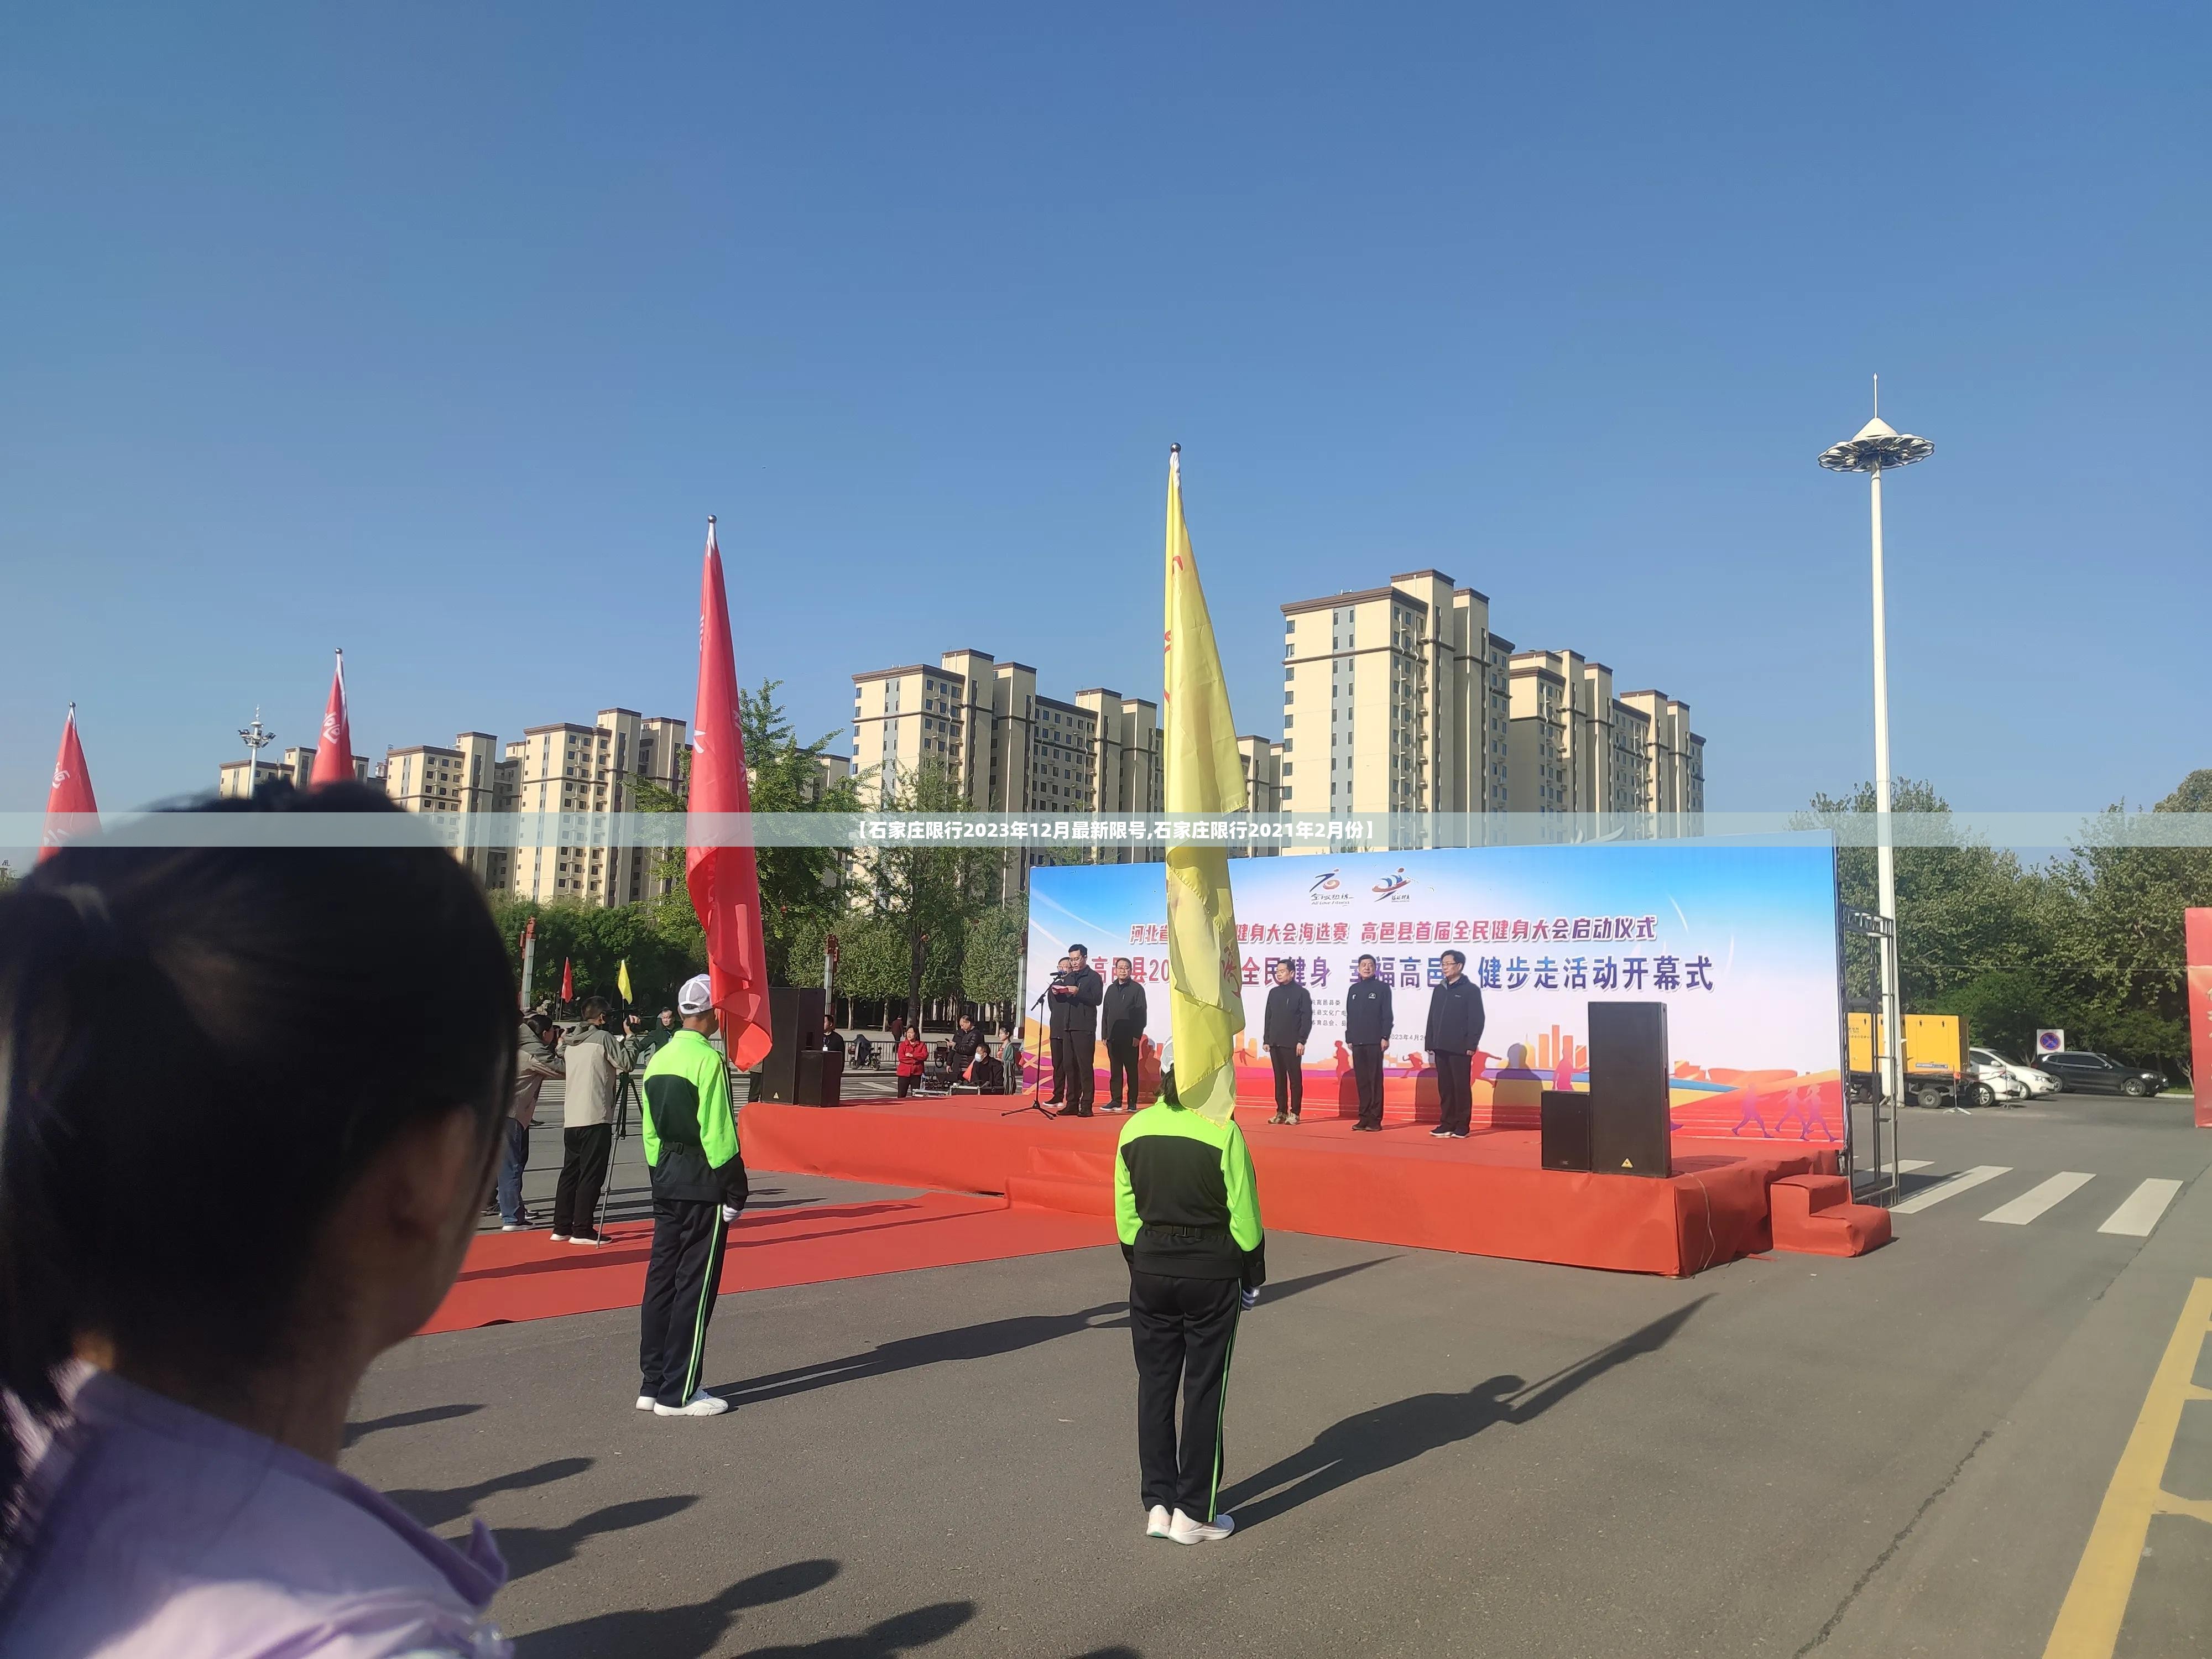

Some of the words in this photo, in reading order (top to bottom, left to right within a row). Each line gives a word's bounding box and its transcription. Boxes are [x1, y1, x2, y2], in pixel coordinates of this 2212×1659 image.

[1361, 916, 1656, 942] 高邑县首届全民健身大会启动仪式
[1477, 955, 1713, 990] 健步走活动开幕式
